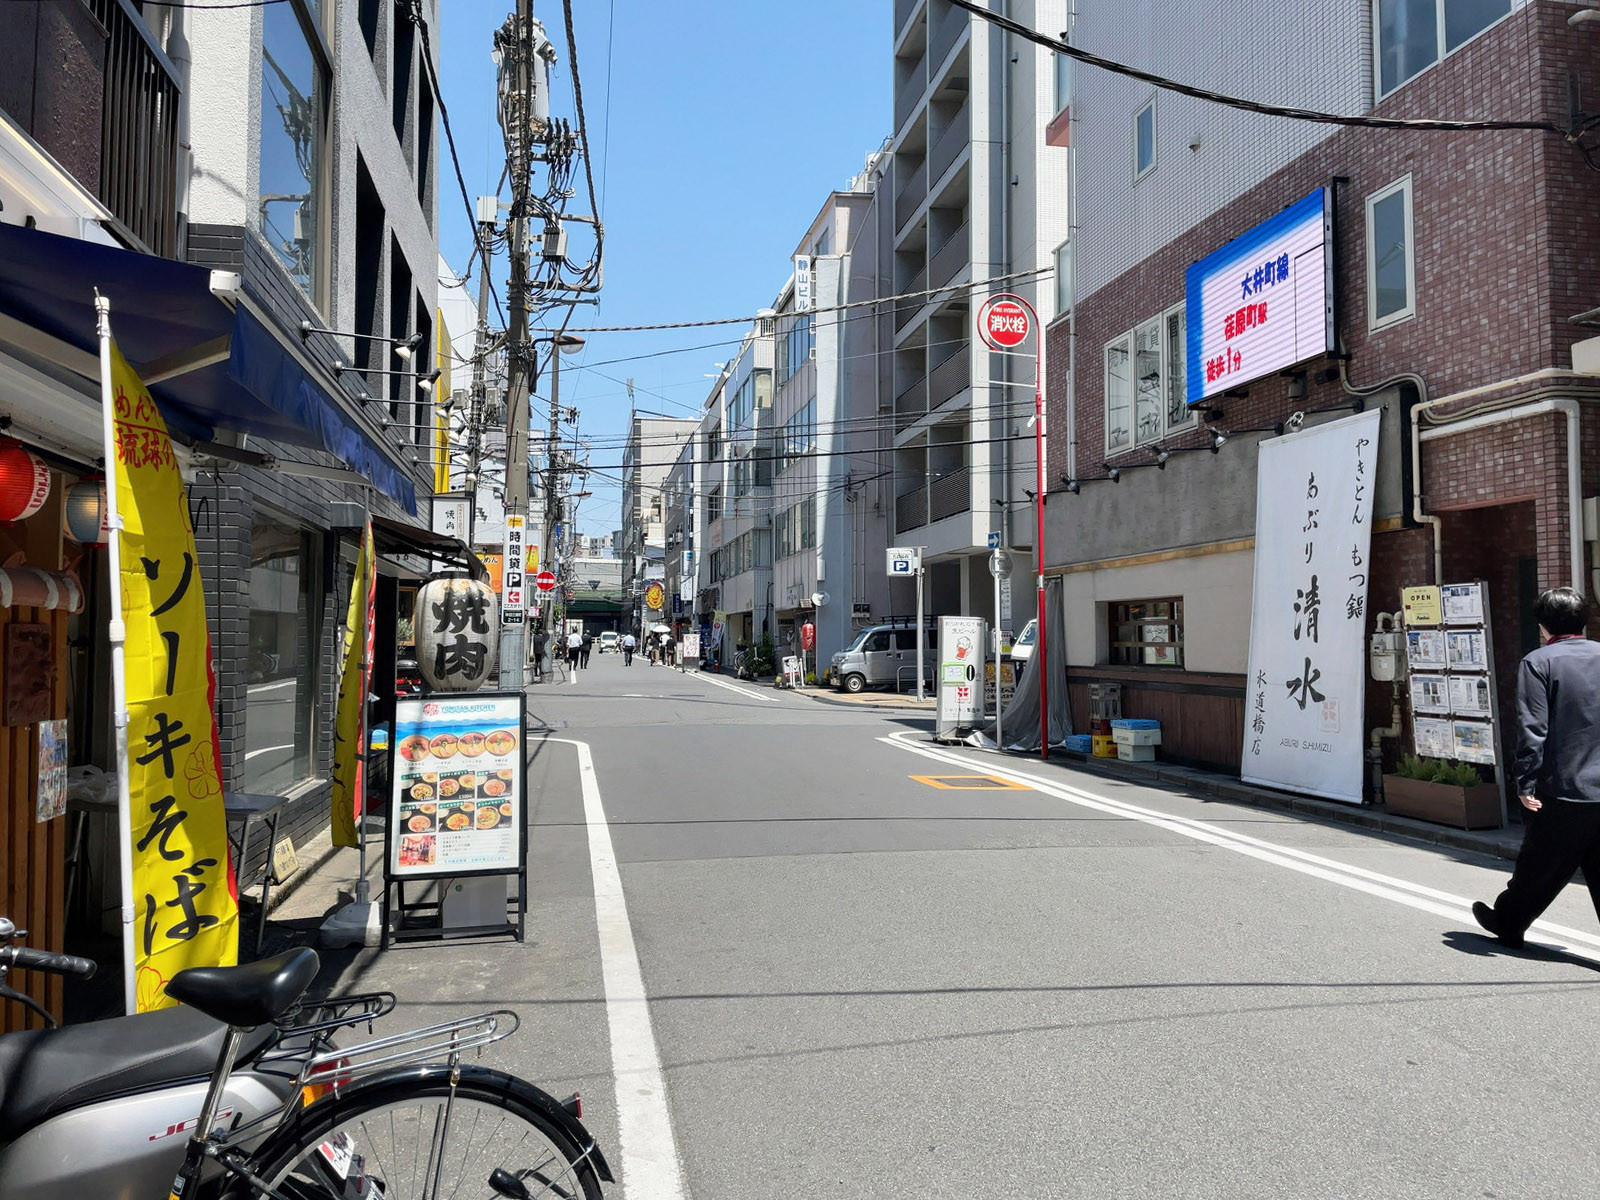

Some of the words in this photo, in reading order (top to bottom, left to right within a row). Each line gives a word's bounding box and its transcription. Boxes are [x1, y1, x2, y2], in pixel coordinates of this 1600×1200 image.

[1241, 252, 1289, 300] 大井町線
[990, 314, 1026, 334] 消火栓
[1223, 301, 1268, 341] 荏原町駅
[1205, 346, 1243, 383] 徒歩1分
[1352, 438, 1370, 525] やきとん
[509, 531, 521, 570] 時間貸
[1410, 594, 1431, 602] OPEN
[431, 587, 491, 681] 焼肉
[470, 703, 497, 712] KITCHEN
[1251, 669, 1267, 755] 水道橋店
[135, 551, 219, 956] ソーキそば
[1279, 737, 1299, 749] ABURI
[1302, 740, 1332, 753] SHIMIZU
